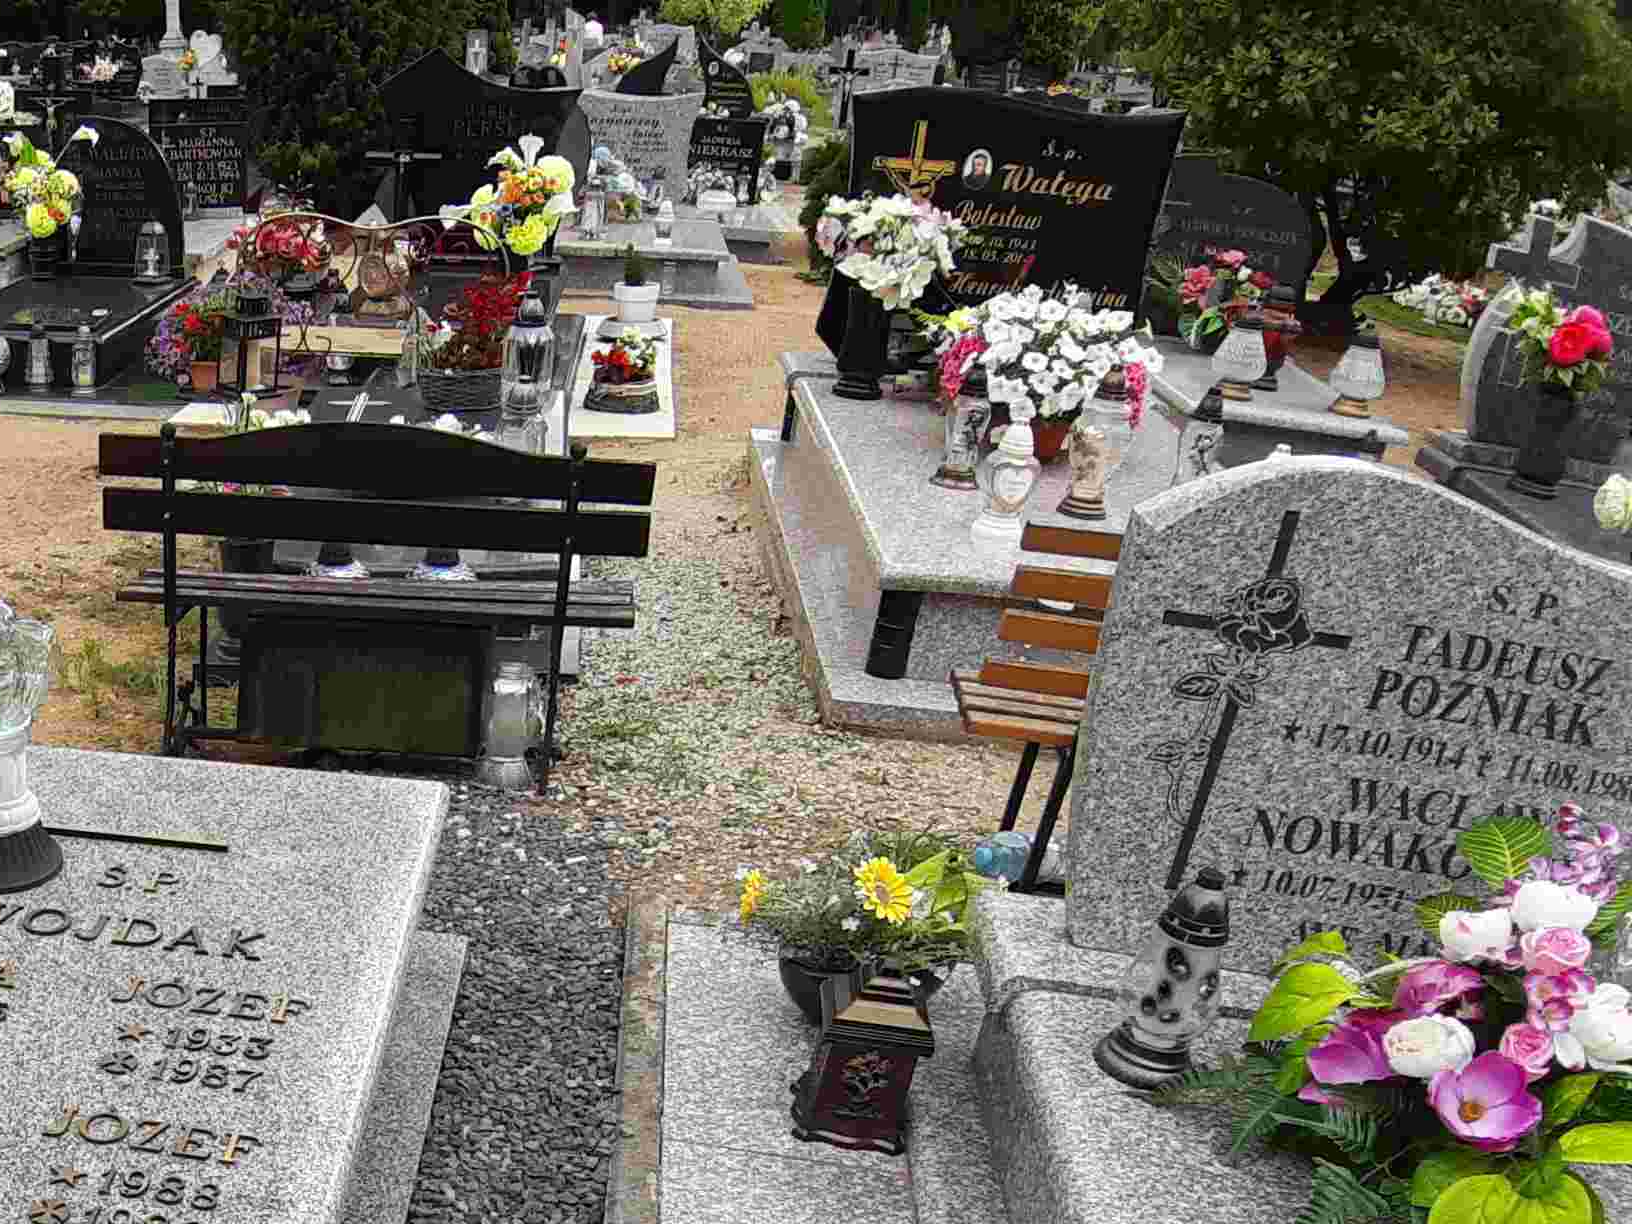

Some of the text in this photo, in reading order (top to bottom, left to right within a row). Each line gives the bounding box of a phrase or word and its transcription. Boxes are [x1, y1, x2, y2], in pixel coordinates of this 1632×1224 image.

[1402, 623, 1614, 697] TADEUSZ
[1245, 808, 1474, 881] NOWAKO
[163, 1027, 274, 1060] 1933
[149, 1057, 265, 1094] 1987
[97, 1164, 221, 1211] 1988
